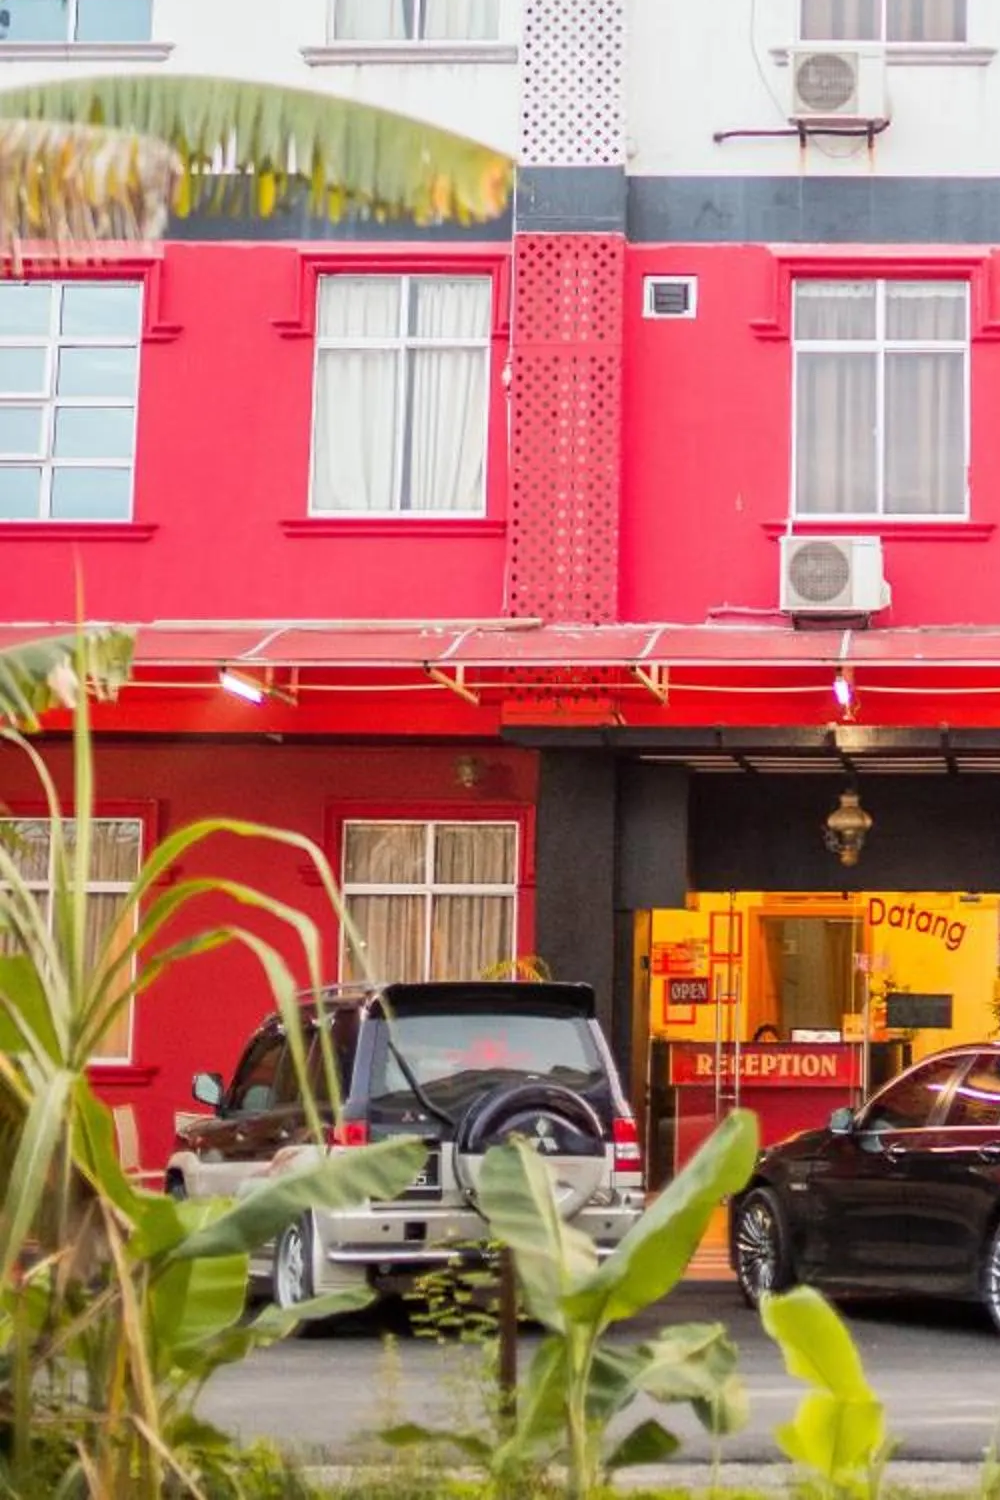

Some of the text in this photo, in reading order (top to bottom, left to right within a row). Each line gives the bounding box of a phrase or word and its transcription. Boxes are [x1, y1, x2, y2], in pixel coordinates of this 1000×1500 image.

[868, 897, 967, 951] Datang
[671, 982, 708, 1001] OPEN
[696, 1053, 838, 1077] RECEPTION
